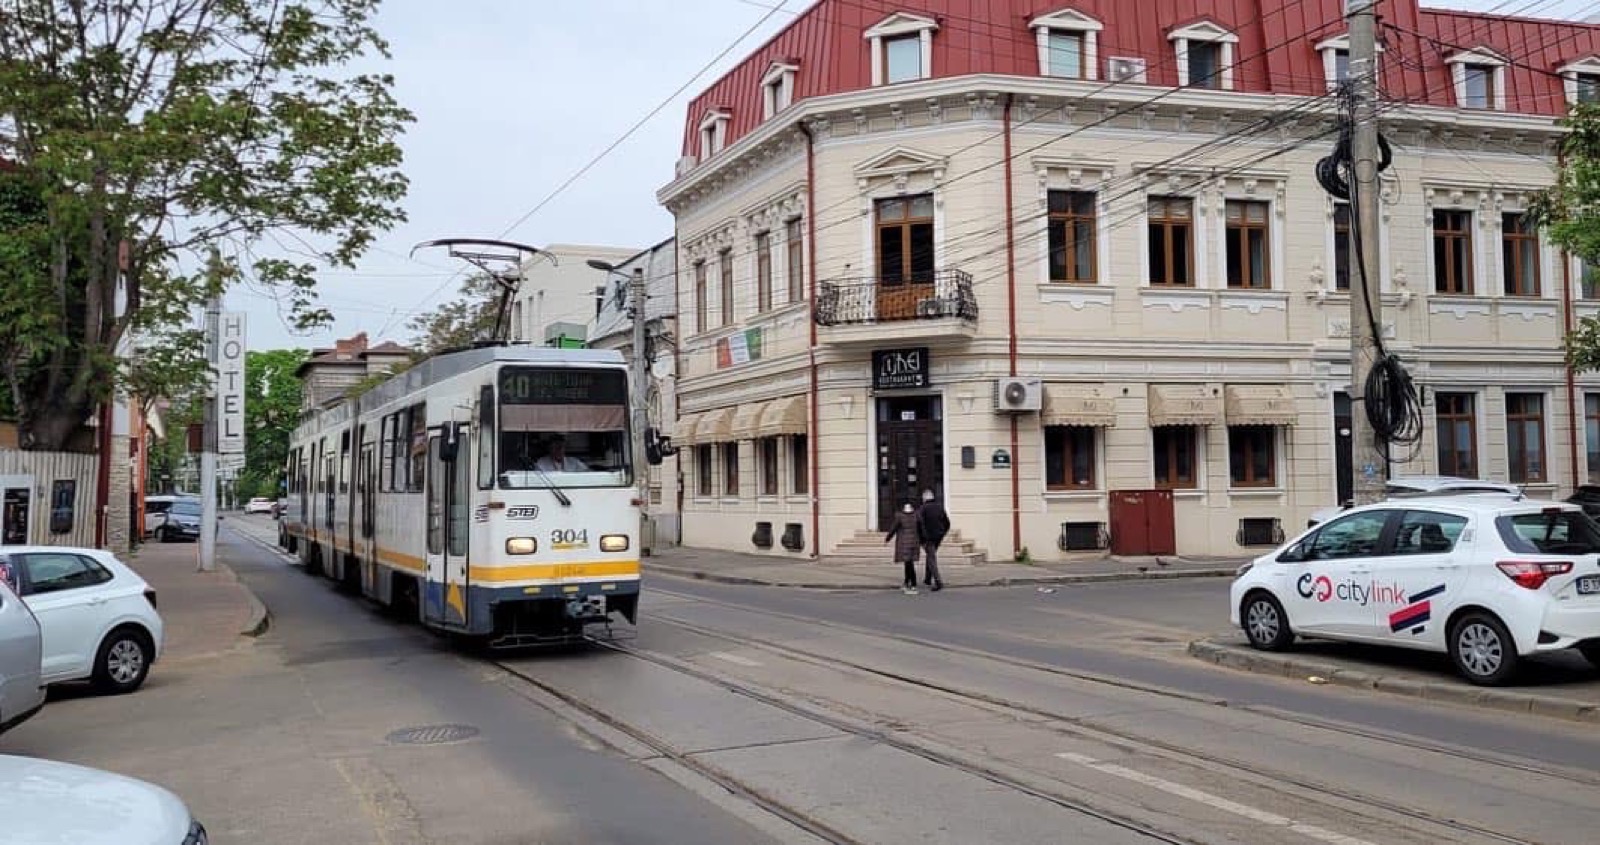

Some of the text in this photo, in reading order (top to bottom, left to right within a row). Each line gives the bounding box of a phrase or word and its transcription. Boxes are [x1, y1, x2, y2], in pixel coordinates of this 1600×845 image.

[223, 317, 242, 437] HOTEL
[506, 507, 537, 518] STB
[551, 528, 589, 544] 304
[1336, 579, 1407, 607] citylink
